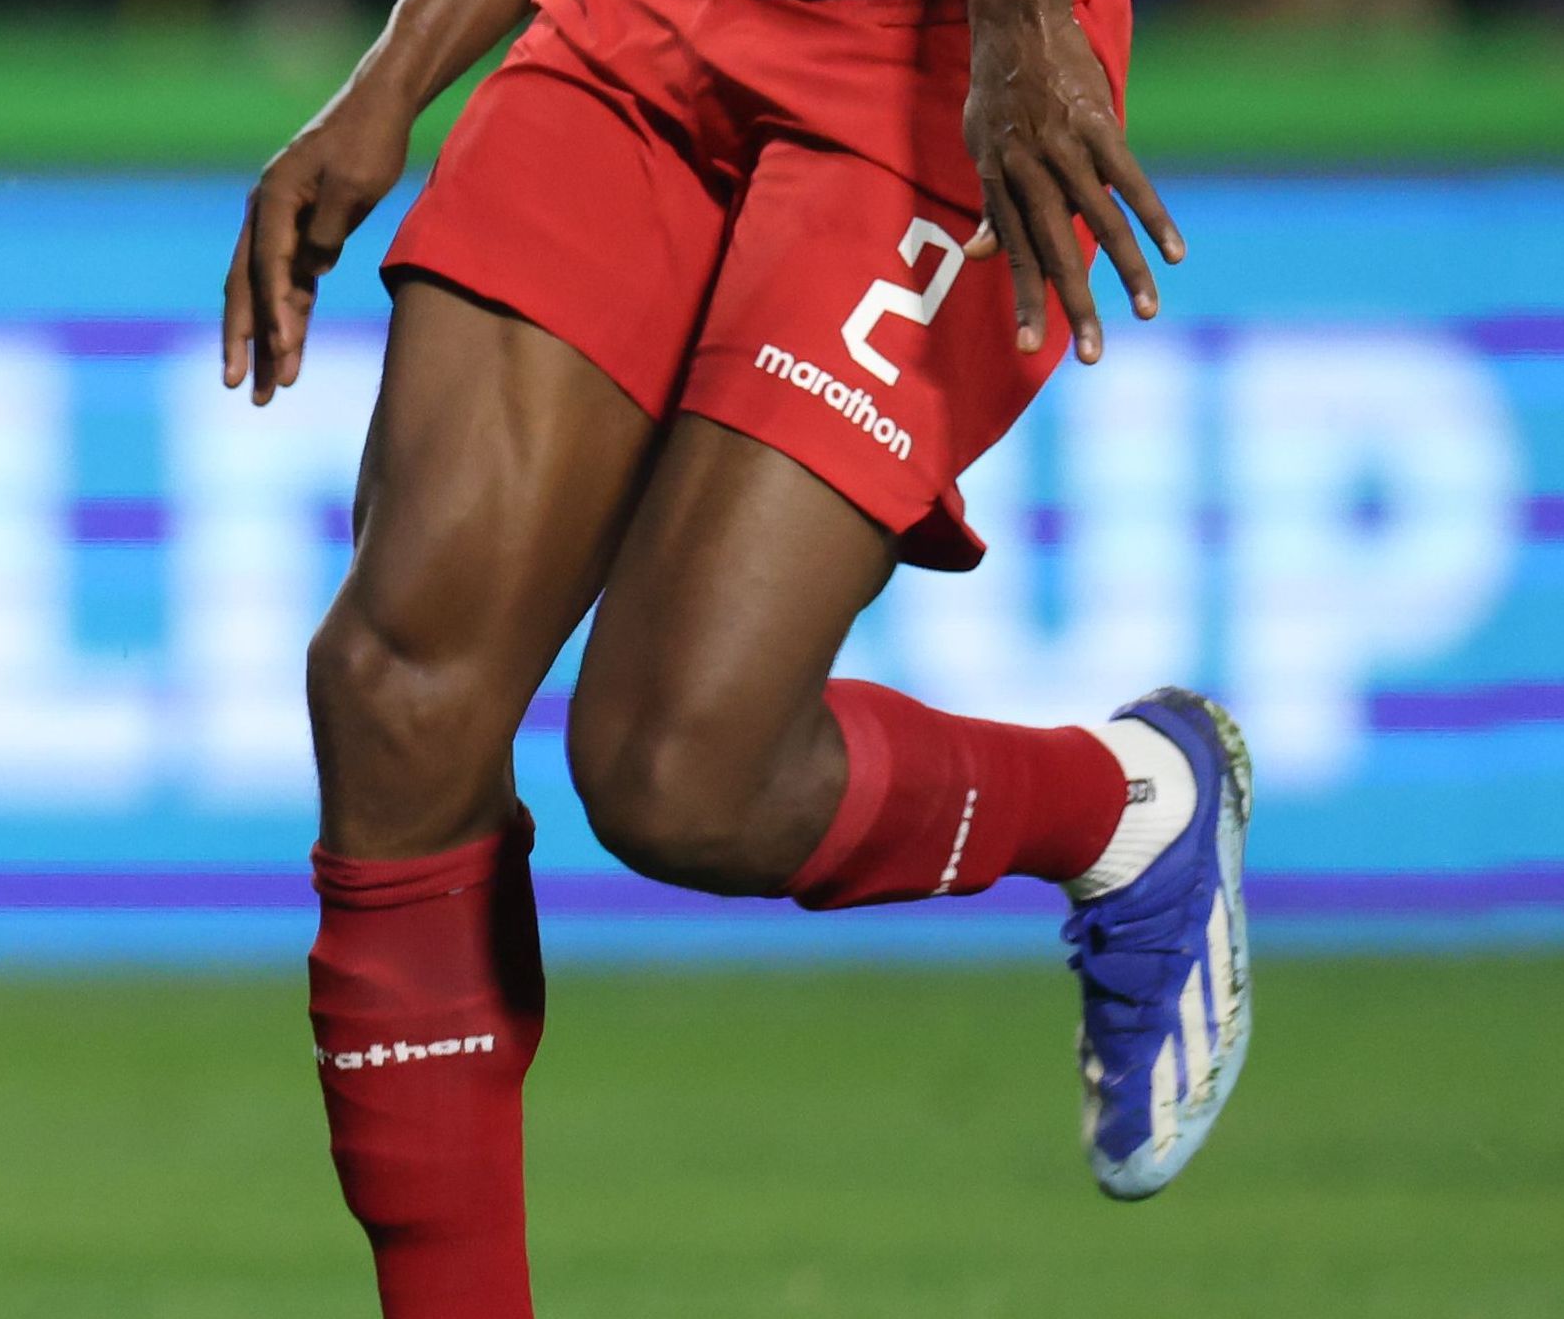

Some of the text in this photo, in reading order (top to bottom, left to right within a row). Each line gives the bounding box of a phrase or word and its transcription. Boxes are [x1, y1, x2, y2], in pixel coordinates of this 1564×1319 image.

[840, 216, 966, 387] 2
[754, 343, 913, 461] marathon
[893, 325, 1528, 798] UP
